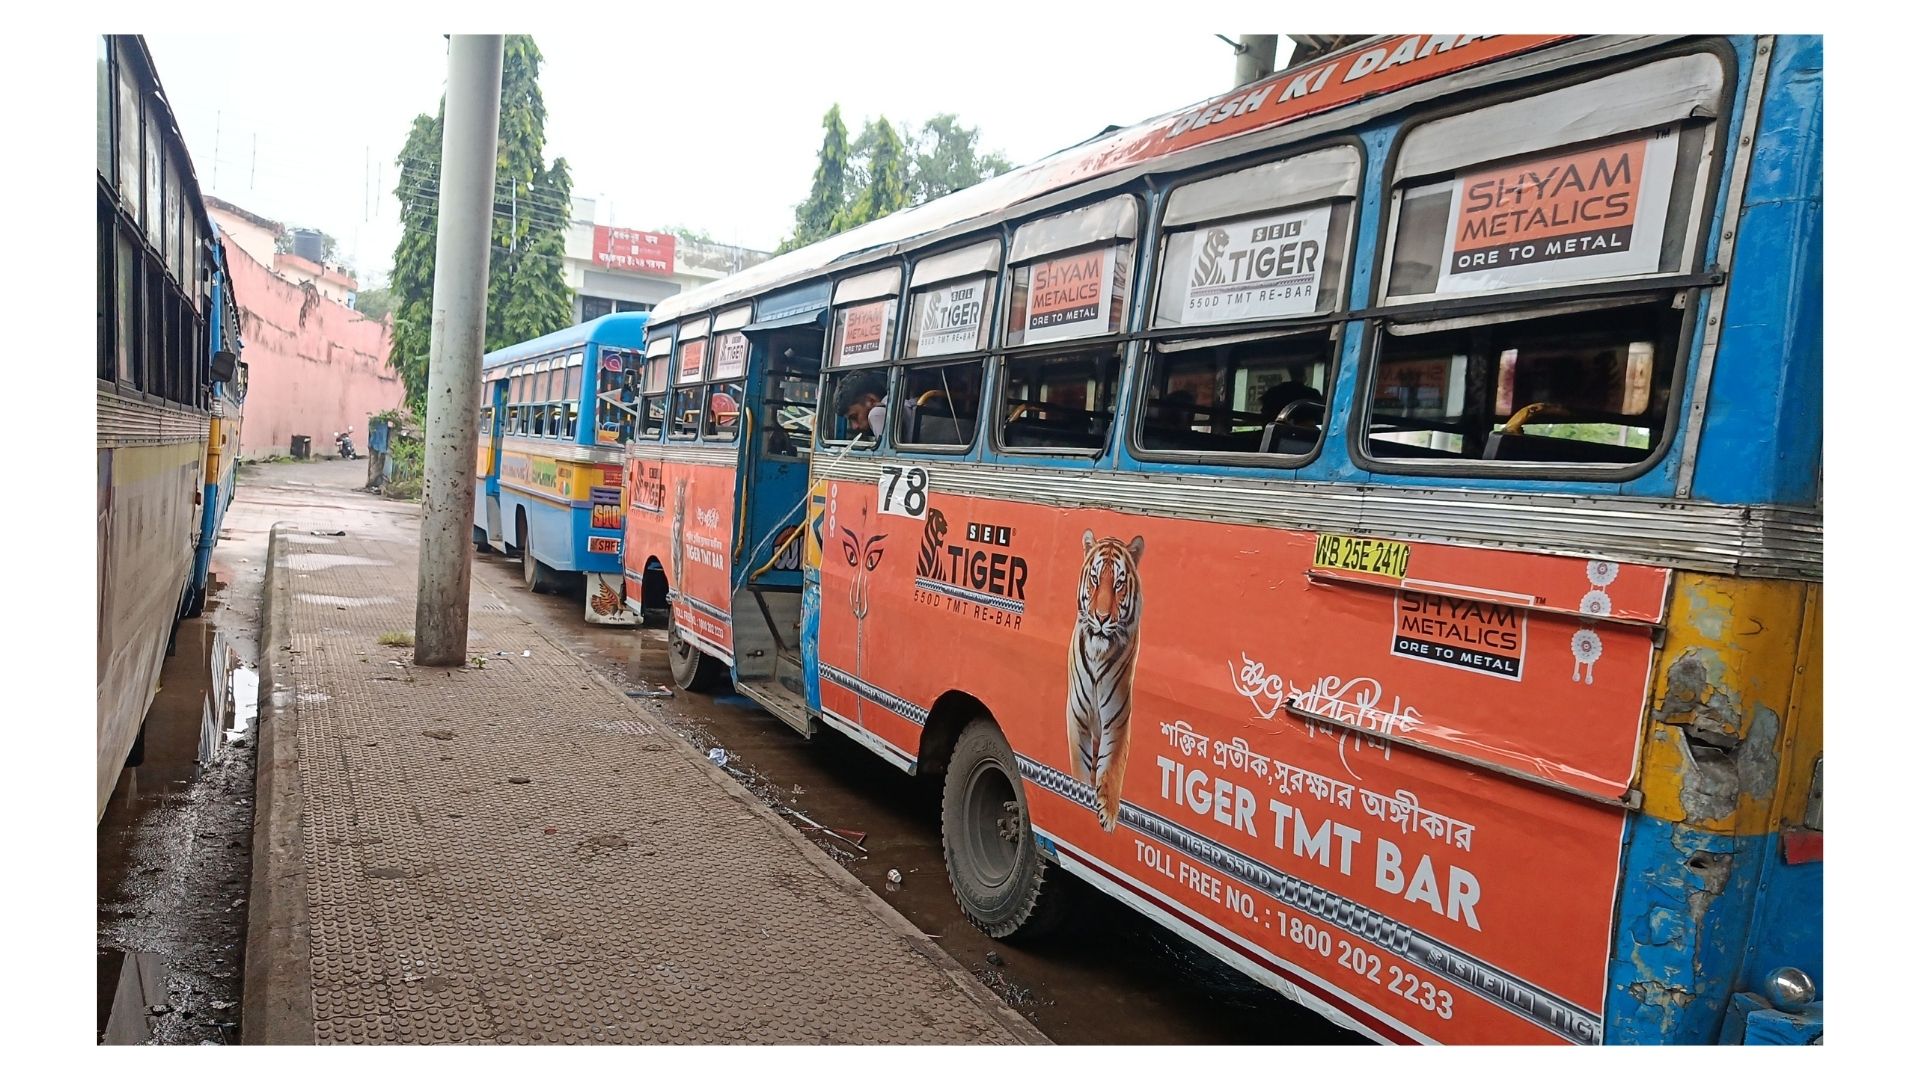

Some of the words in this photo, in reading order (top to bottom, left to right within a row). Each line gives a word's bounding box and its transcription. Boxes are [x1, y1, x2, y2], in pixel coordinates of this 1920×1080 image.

[1166, 84, 1276, 138] DESH
[1278, 63, 1340, 104] KI
[1466, 153, 1631, 213] SHYAM
[1254, 222, 1299, 241] SEL
[1461, 192, 1629, 242] METALICS
[1229, 240, 1319, 282] TIGER
[1458, 250, 1498, 268] ORE
[1509, 245, 1535, 261] TO
[1545, 233, 1622, 255] METAL
[1036, 257, 1099, 291] SHYAM
[940, 301, 980, 328] TIGER
[1033, 283, 1098, 308] METALICS
[1190, 297, 1219, 309] 550D
[1227, 292, 1251, 304] TMT
[1260, 285, 1312, 301] RE-BAR
[848, 308, 879, 327] SHYAM
[1032, 315, 1049, 326] ORE
[1052, 313, 1063, 322] TO
[1066, 308, 1096, 320] METAL
[882, 466, 926, 516] 78
[968, 523, 1008, 545] SEL
[948, 545, 1028, 600] TIGER
[1315, 535, 1340, 566] WB
[1342, 538, 1371, 571] 25E
[1372, 542, 1410, 577] 2410
[914, 590, 940, 607] 550D
[947, 598, 968, 615] TMT
[974, 605, 1022, 630] RE-BAR
[1402, 592, 1516, 628] SHYAM
[1401, 615, 1517, 651] METALICS
[1399, 640, 1429, 654] ORE
[1435, 648, 1454, 659] TO
[1460, 652, 1514, 672] METAL
[1159, 720, 1209, 759] শক্তির
[1359, 789, 1476, 852] অঙ্গীকার
[1126, 807, 1169, 840] SEL
[1175, 830, 1222, 867] TIGER
[1157, 755, 1257, 838] TIGER
[1270, 799, 1361, 876] TMT
[1375, 838, 1482, 932] BAR
[1134, 839, 1175, 879] TOLL
[1179, 861, 1221, 903] FREE
[1226, 885, 1259, 923] NO.
[1278, 911, 1331, 957] 1800
[1338, 940, 1381, 985] 202
[1387, 965, 1454, 1020] 2233
[1450, 958, 1532, 1011] SEL
